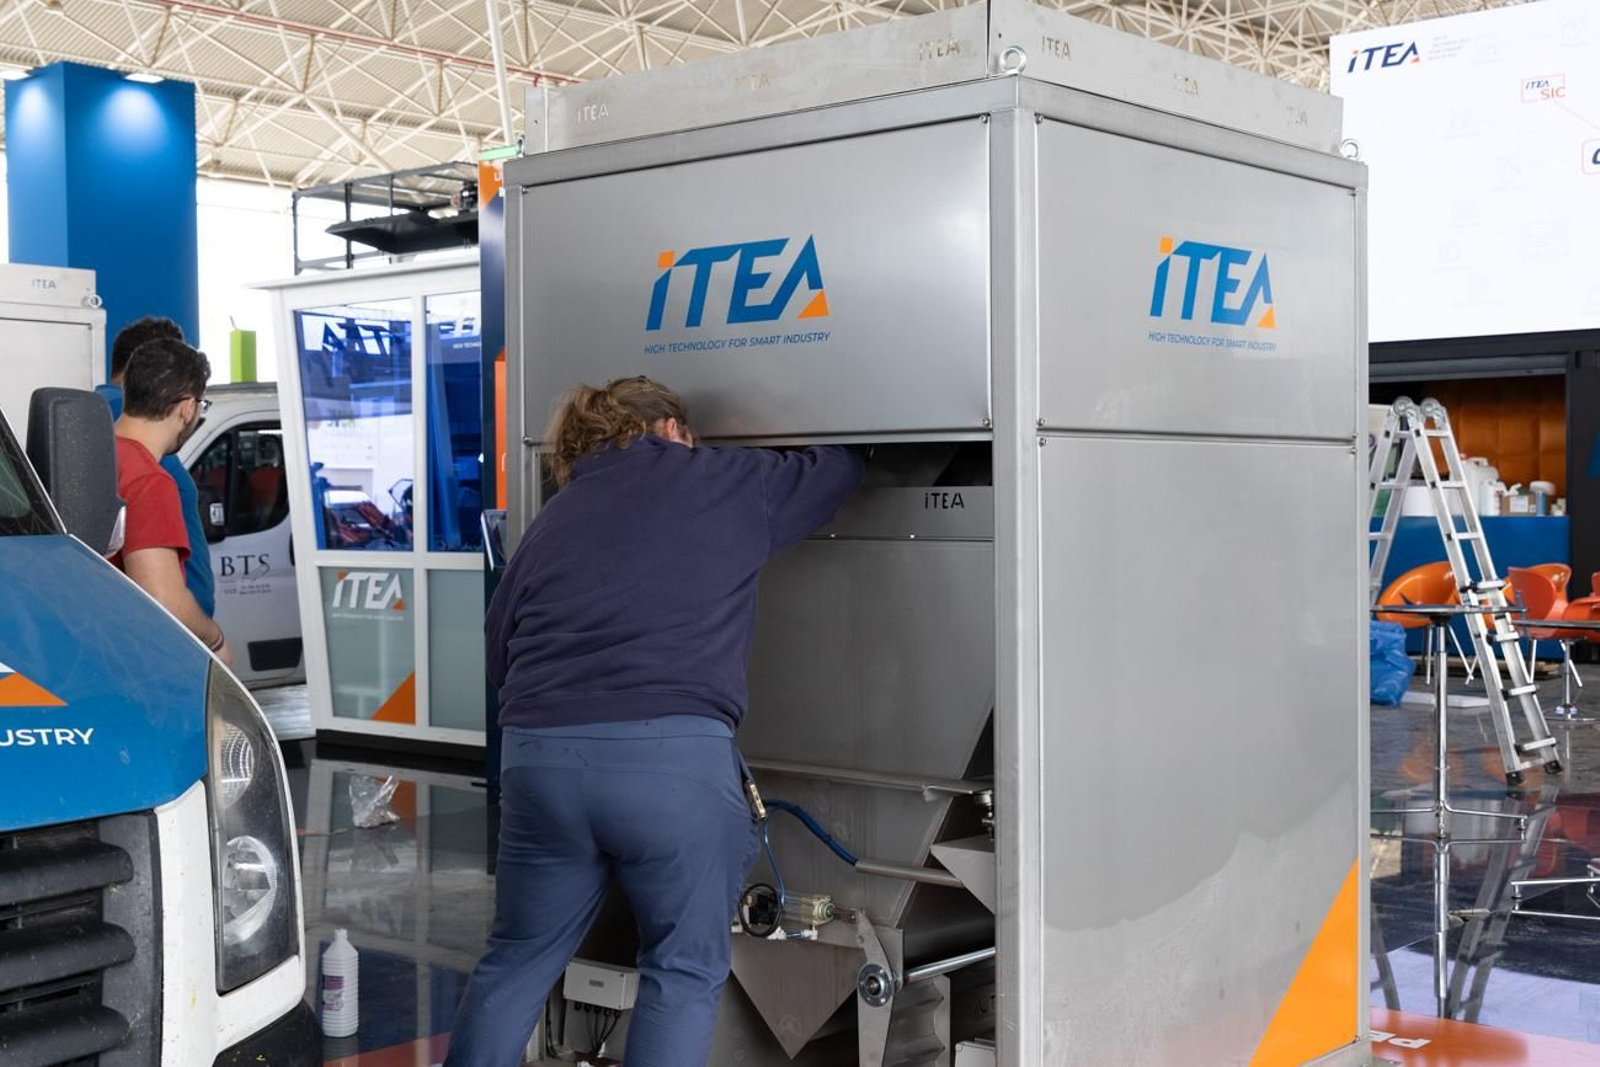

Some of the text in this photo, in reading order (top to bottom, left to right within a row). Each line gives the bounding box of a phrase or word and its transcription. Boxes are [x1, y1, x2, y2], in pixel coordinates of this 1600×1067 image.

[1540, 86, 1566, 100] SIC
[645, 233, 829, 331] iTEA
[1149, 236, 1277, 328] iTEA
[645, 332, 832, 355] HIGH TECHNOLOGY FOR SMART INDUSTRY
[1148, 331, 1277, 351] HIGH TECHNOLOGY FOR SMART INDUSTRY
[221, 553, 270, 577] BTS
